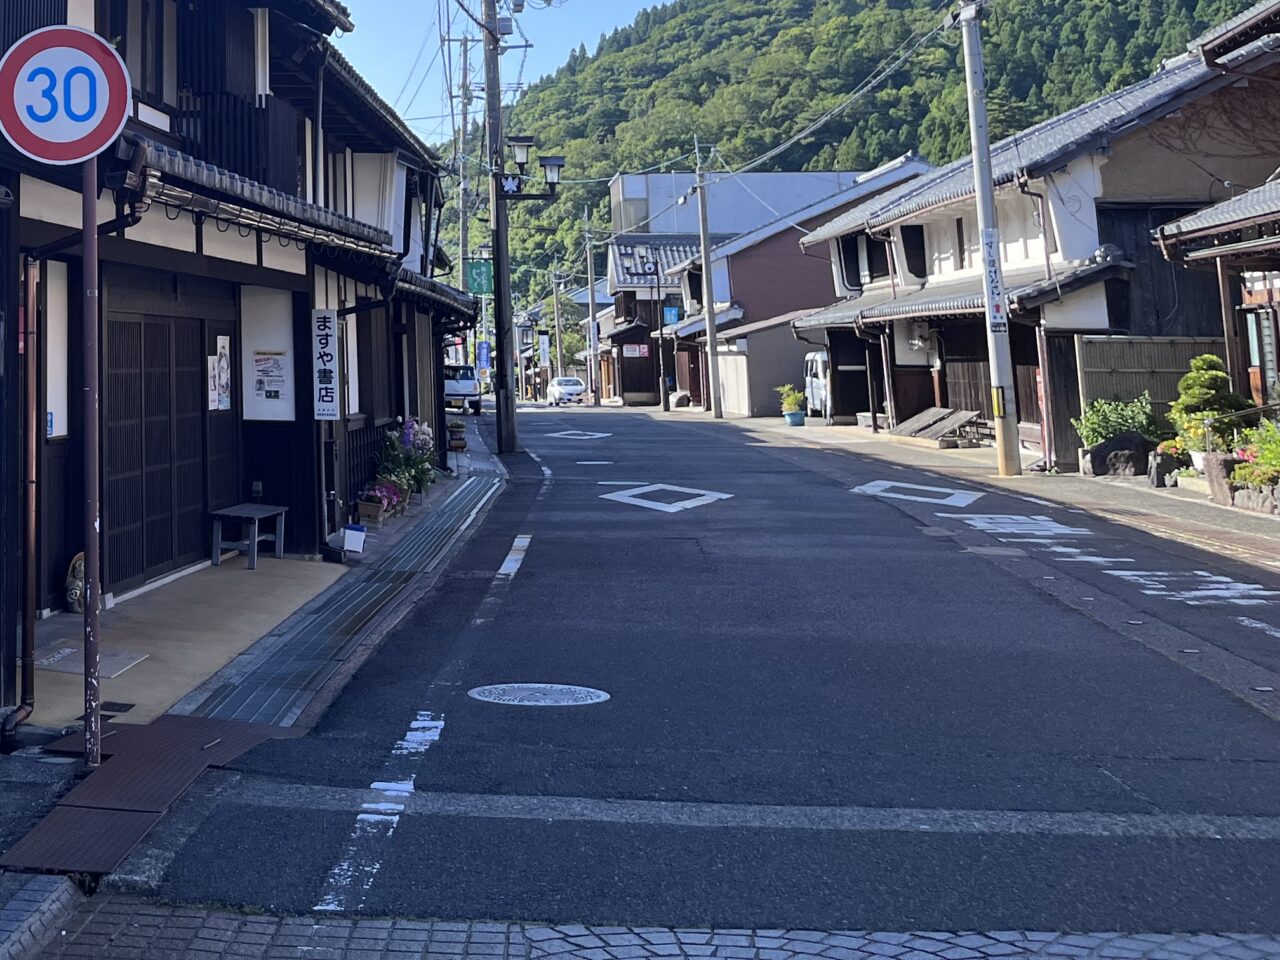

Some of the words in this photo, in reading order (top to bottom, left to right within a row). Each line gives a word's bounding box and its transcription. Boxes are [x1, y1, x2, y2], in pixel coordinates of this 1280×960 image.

[26, 66, 97, 123] 30
[315, 315, 335, 403] ますや書店
